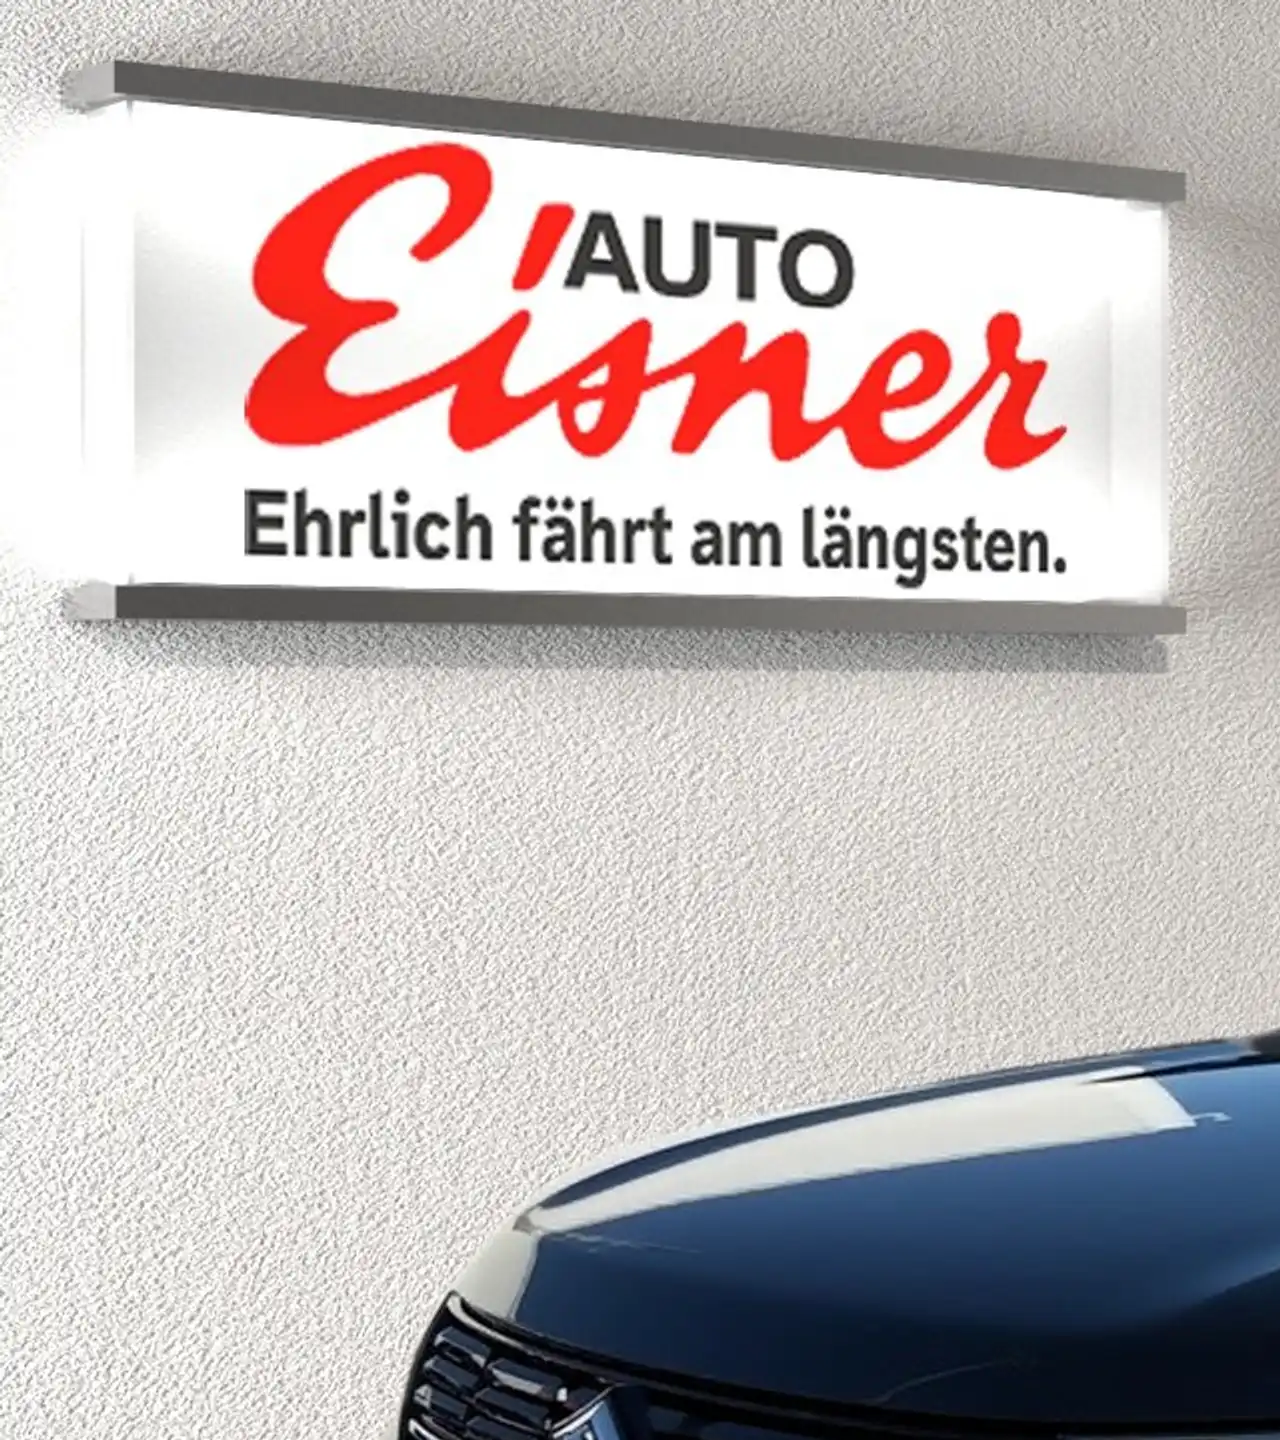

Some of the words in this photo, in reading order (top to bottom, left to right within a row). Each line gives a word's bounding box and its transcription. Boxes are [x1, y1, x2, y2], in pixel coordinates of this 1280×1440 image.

[244, 142, 1066, 471] Eisner
[564, 211, 854, 309] AUTO
[244, 488, 492, 561] Ehrlich
[512, 496, 673, 565] fährt
[691, 520, 782, 567] am
[803, 506, 1067, 589] längsten.
